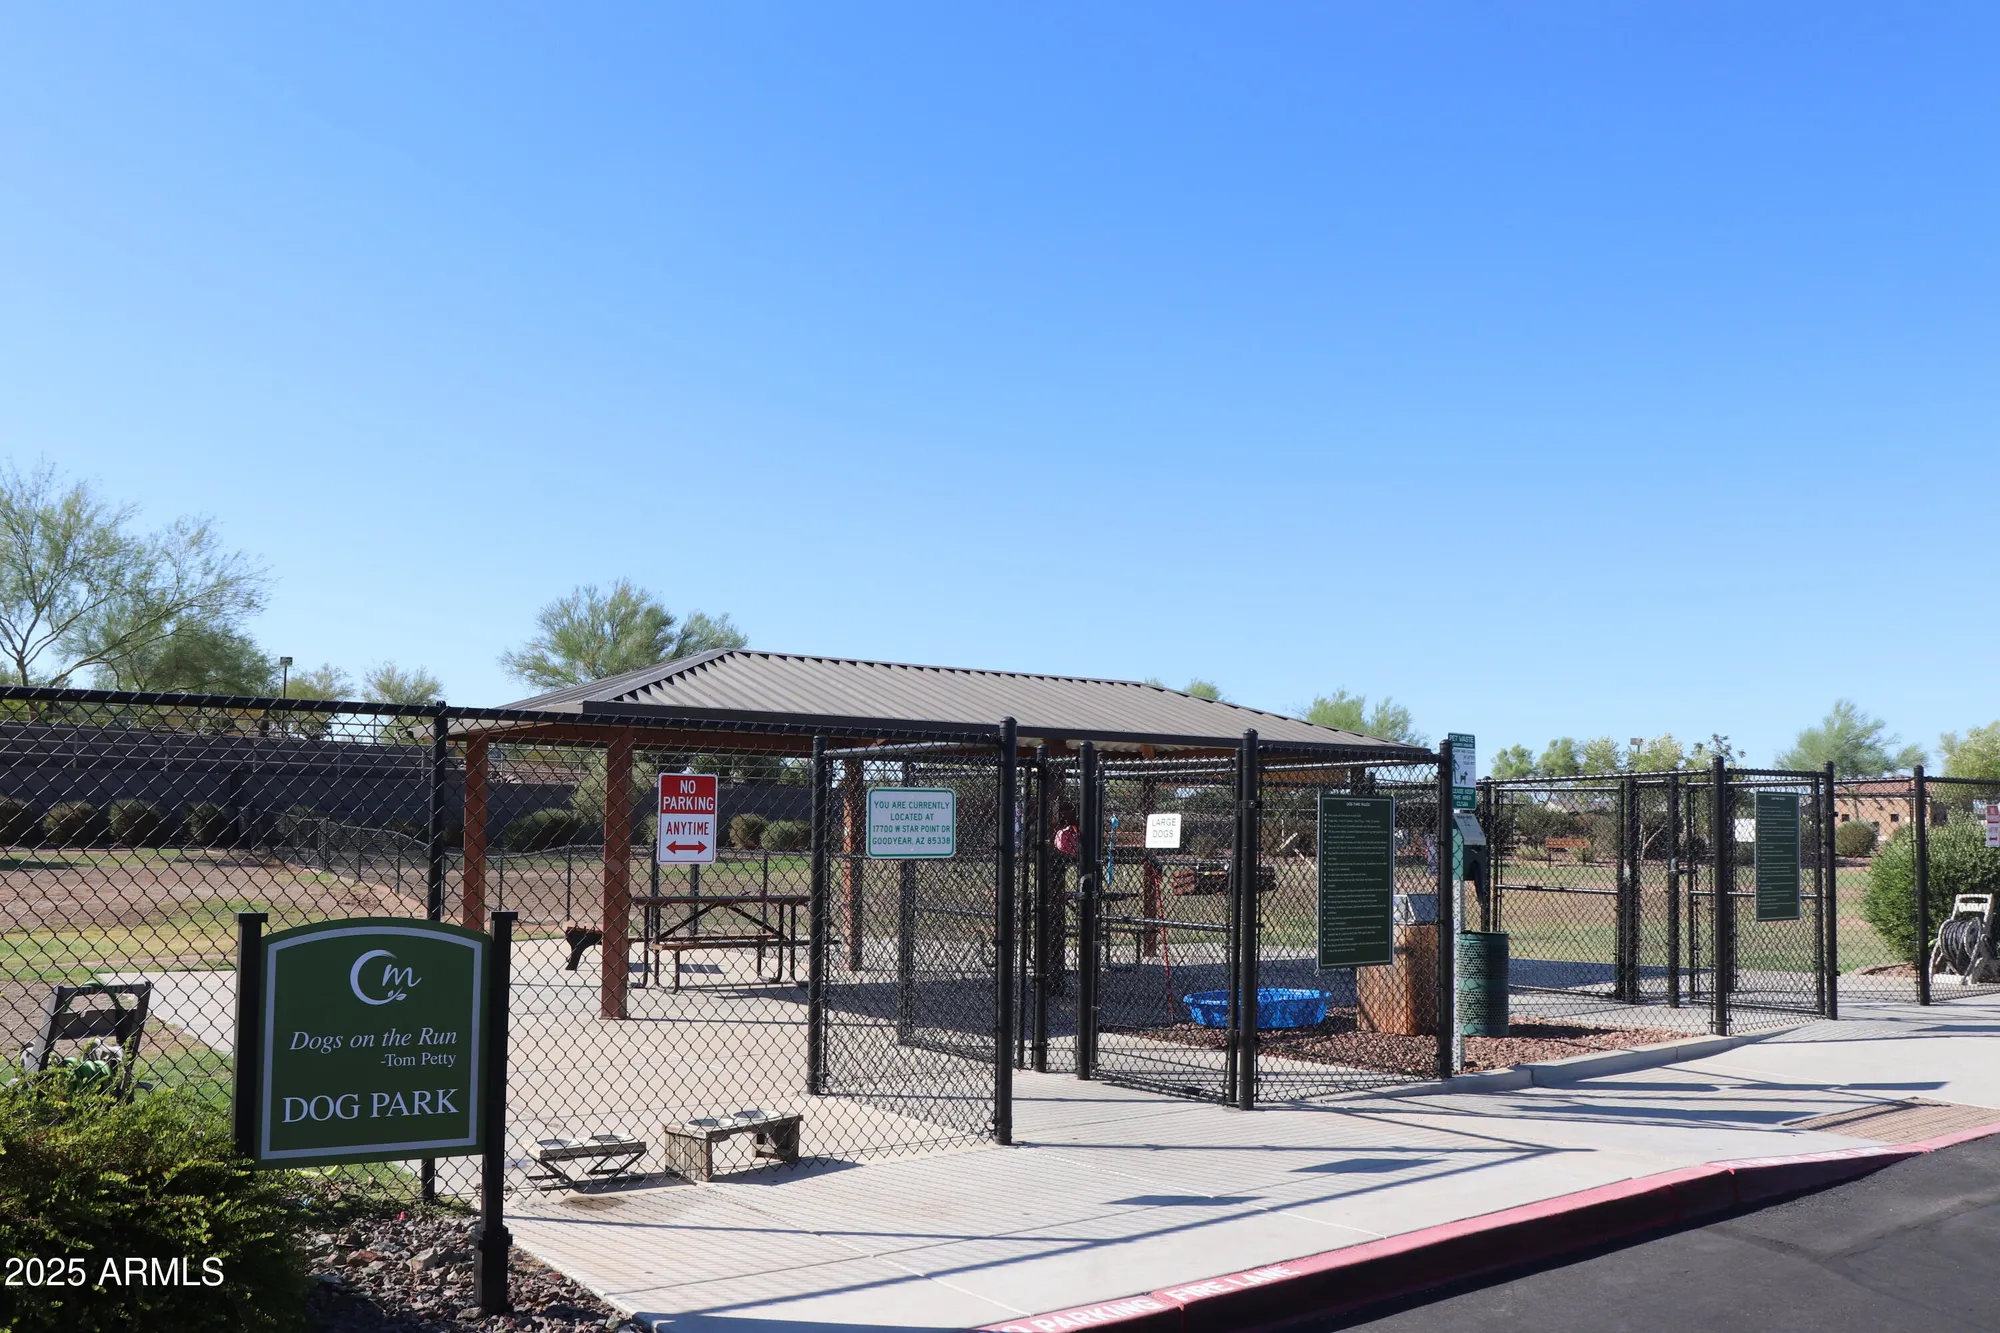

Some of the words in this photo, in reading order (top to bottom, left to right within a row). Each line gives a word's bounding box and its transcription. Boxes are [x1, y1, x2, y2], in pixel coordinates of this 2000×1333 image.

[1458, 735, 1474, 743] WASTE
[680, 779, 696, 794] NO
[663, 796, 714, 811] PARKING
[874, 800, 890, 809] YOU
[892, 801, 906, 809] ARE
[908, 801, 950, 810] CURRENTLY
[890, 813, 923, 821] LOCATED
[925, 813, 934, 821] AT
[1152, 818, 1176, 827] LARGE
[666, 821, 710, 836] ANYTIME
[872, 825, 893, 833] 17700
[895, 825, 901, 833] W
[902, 825, 919, 833] STAR
[920, 825, 940, 833] POINT
[941, 825, 951, 833] DR
[1152, 829, 1173, 838] DOGS
[915, 837, 925, 845] AZ
[927, 836, 951, 845] 85338
[289, 1031, 344, 1054] Dogs
[350, 1034, 375, 1048] on
[382, 1028, 412, 1047] the
[418, 1027, 457, 1046] Run
[380, 1053, 416, 1067] -Tom
[421, 1052, 457, 1067] Petty
[282, 1093, 361, 1123] DOG
[370, 1088, 460, 1118] PARK
[1031, 1297, 1164, 1333] PARKING
[1164, 1281, 1235, 1301] FIRE
[1224, 1266, 1302, 1287] LANE
